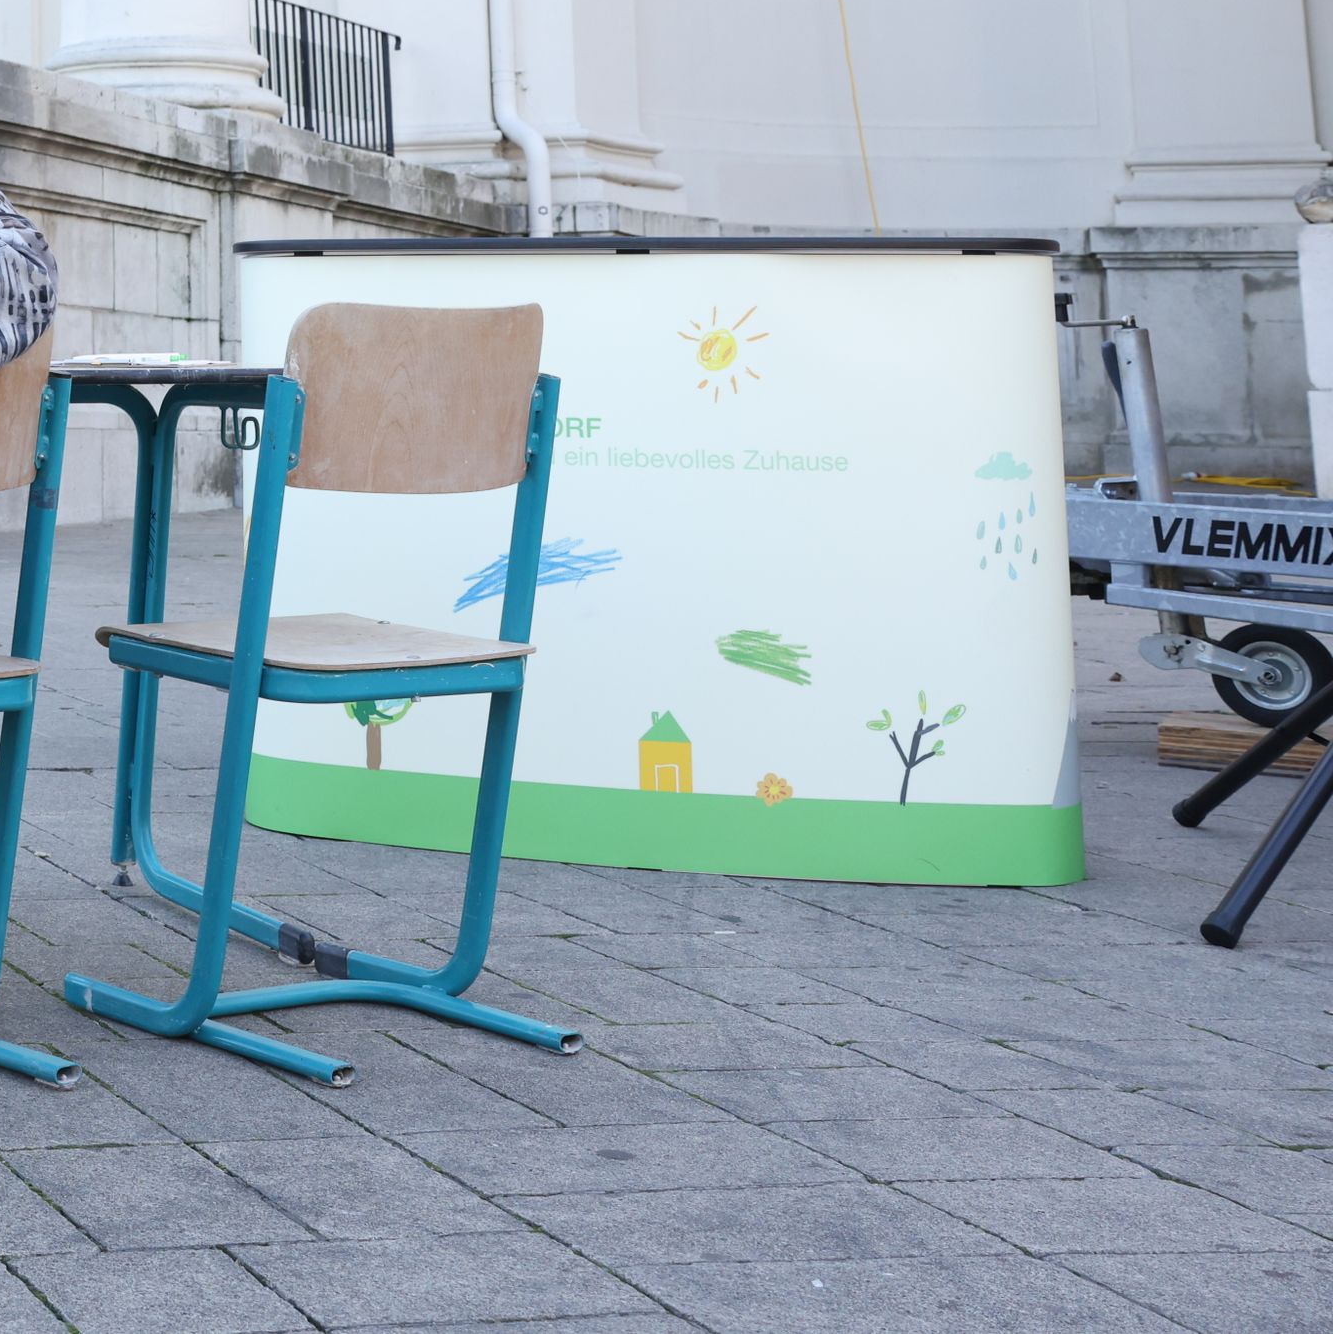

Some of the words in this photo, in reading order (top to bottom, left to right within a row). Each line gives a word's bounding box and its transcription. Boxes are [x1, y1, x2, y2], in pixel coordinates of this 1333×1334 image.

[564, 446, 598, 467] ein
[607, 446, 735, 471] liebevolles
[743, 450, 849, 472] Zuhause
